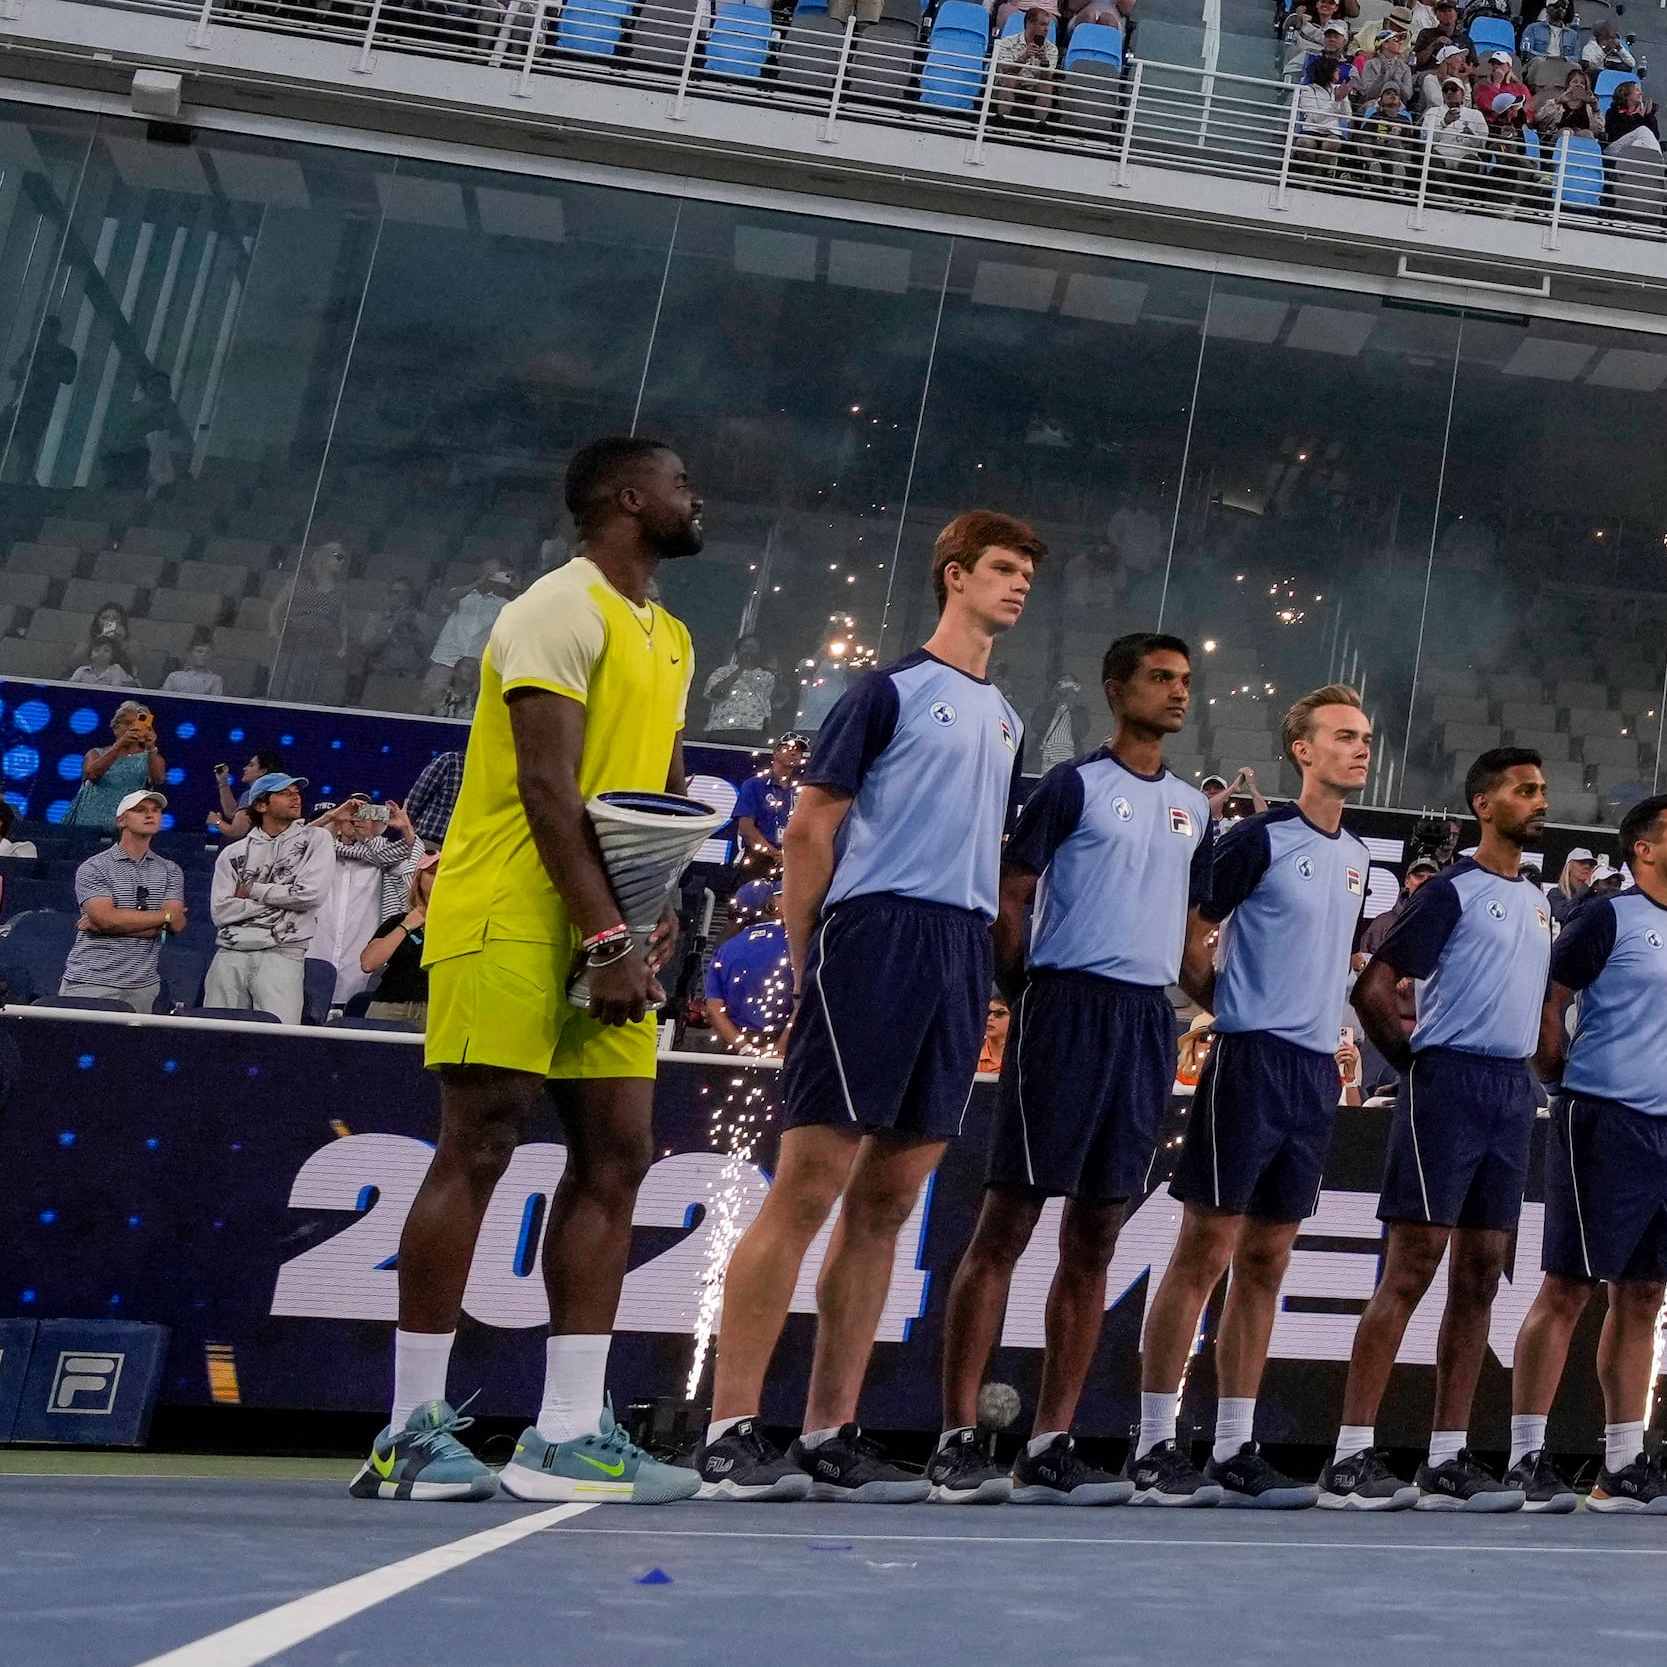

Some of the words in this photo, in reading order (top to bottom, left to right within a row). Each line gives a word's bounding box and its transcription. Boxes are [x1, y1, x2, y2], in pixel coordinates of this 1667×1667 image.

[706, 1456, 735, 1472] FILA
[816, 1459, 841, 1479] FILA
[1037, 1465, 1058, 1482] FILA
[1226, 1471, 1246, 1487] FILA
[1334, 1474, 1356, 1487] FILA
[1437, 1476, 1457, 1492] FILA
